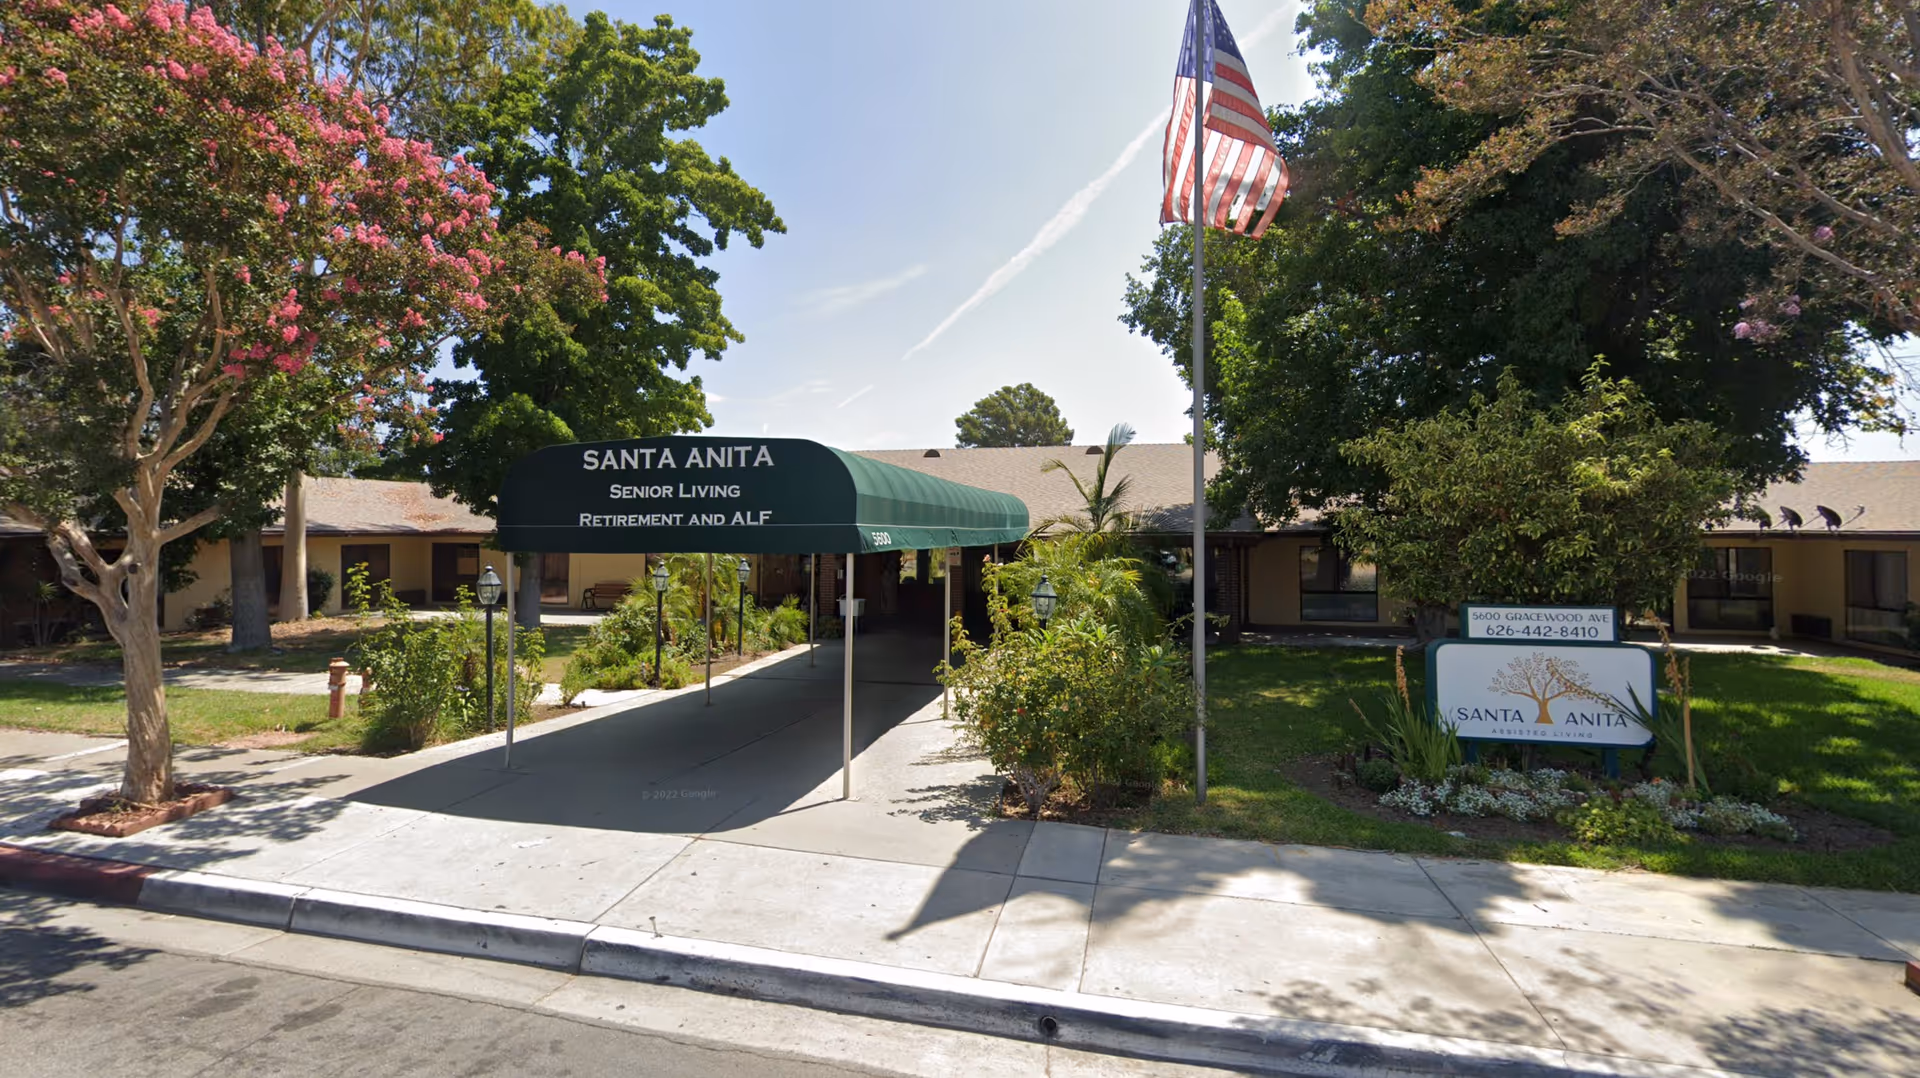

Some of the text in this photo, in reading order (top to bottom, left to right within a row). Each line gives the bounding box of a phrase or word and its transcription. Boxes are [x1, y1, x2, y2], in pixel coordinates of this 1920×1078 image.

[583, 445, 775, 471] SANTA ANITA
[731, 510, 772, 525] ALF
[871, 531, 892, 546] 5600
[1472, 611, 1610, 624] 5600 GRACEWOOD AVE
[1486, 624, 1599, 638] 626-442-8410
[1457, 707, 1628, 728] SANTA ANITA
[1491, 728, 1593, 739] ASSISTED LIVING
